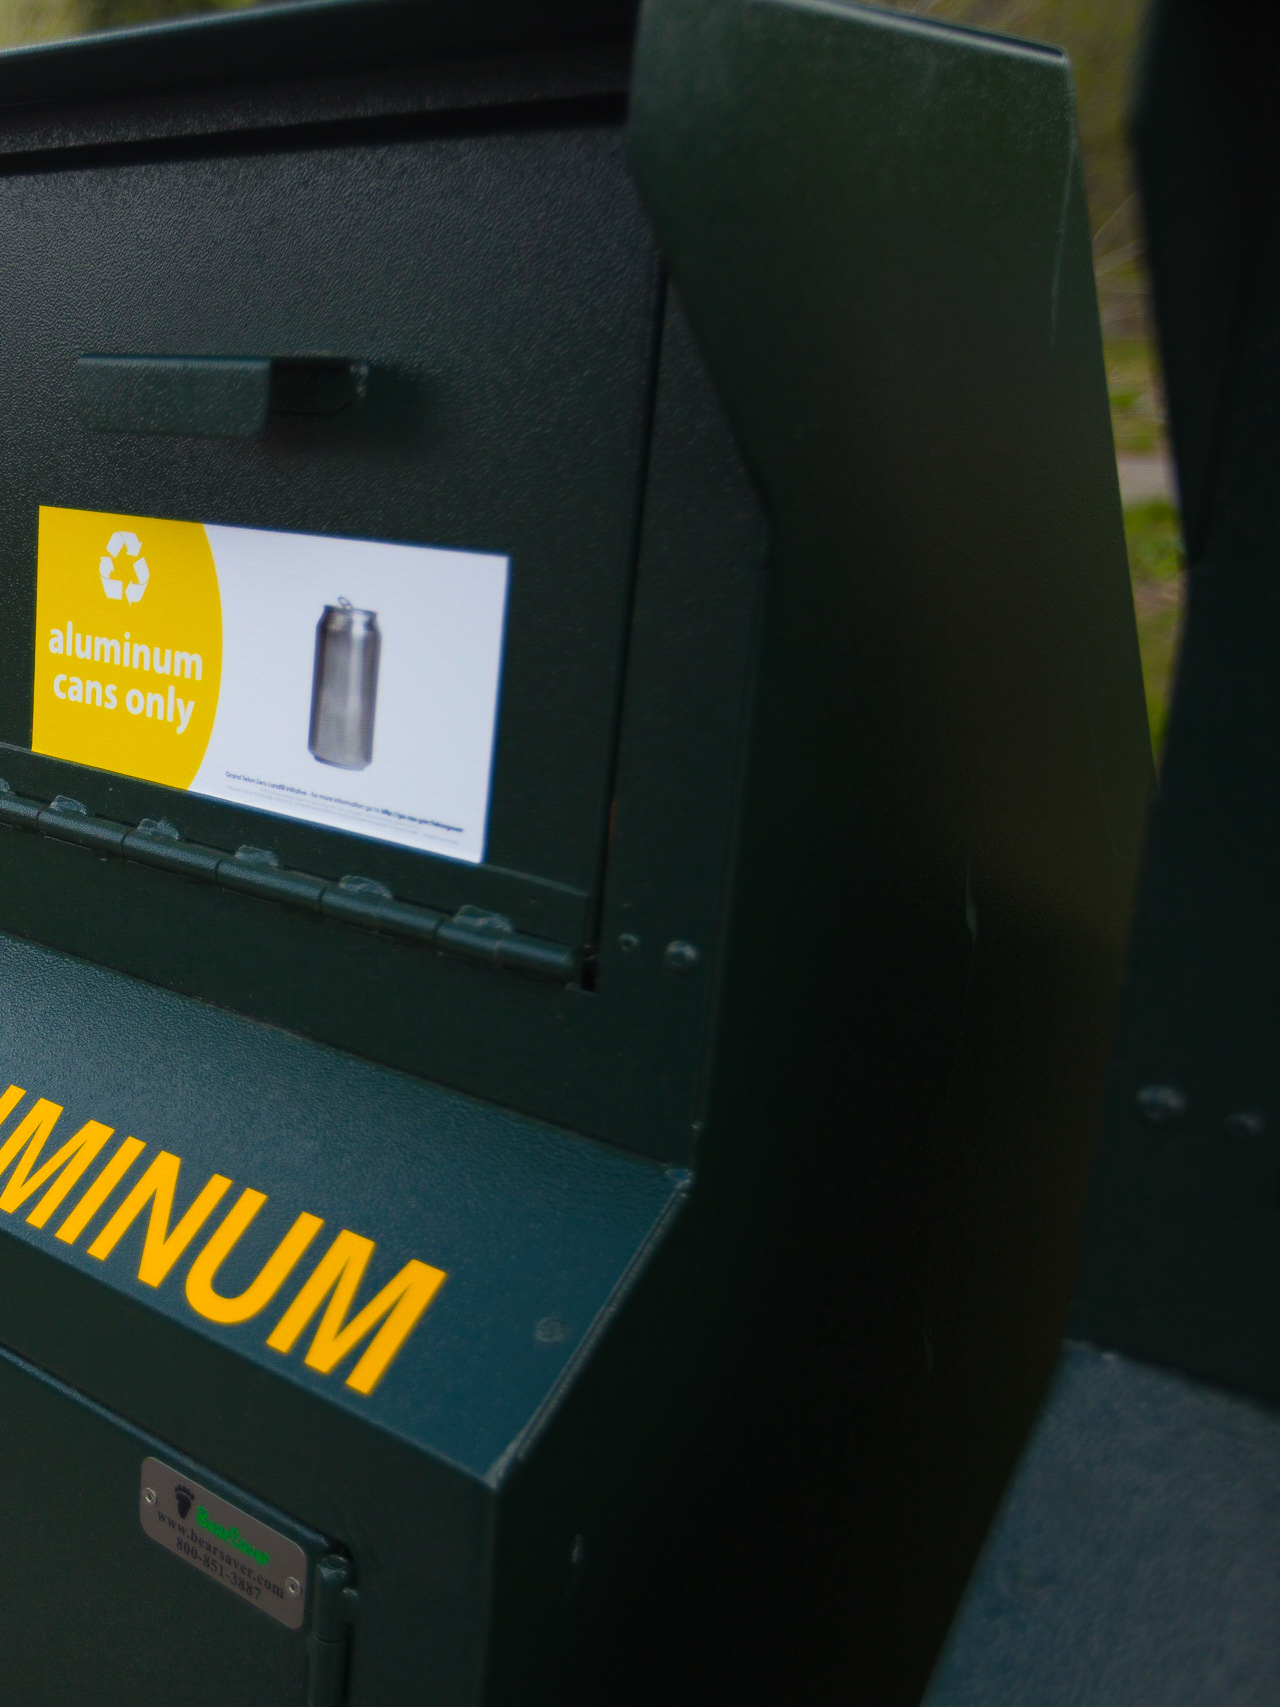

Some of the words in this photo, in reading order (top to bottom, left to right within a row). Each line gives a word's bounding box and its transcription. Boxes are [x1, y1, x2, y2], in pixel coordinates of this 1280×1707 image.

[48, 621, 203, 681] aluminum
[52, 672, 118, 711] cans
[125, 685, 196, 735] only
[157, 1510, 286, 1600] www.bearsaver.com
[175, 1536, 262, 1600] 800-851-3887
